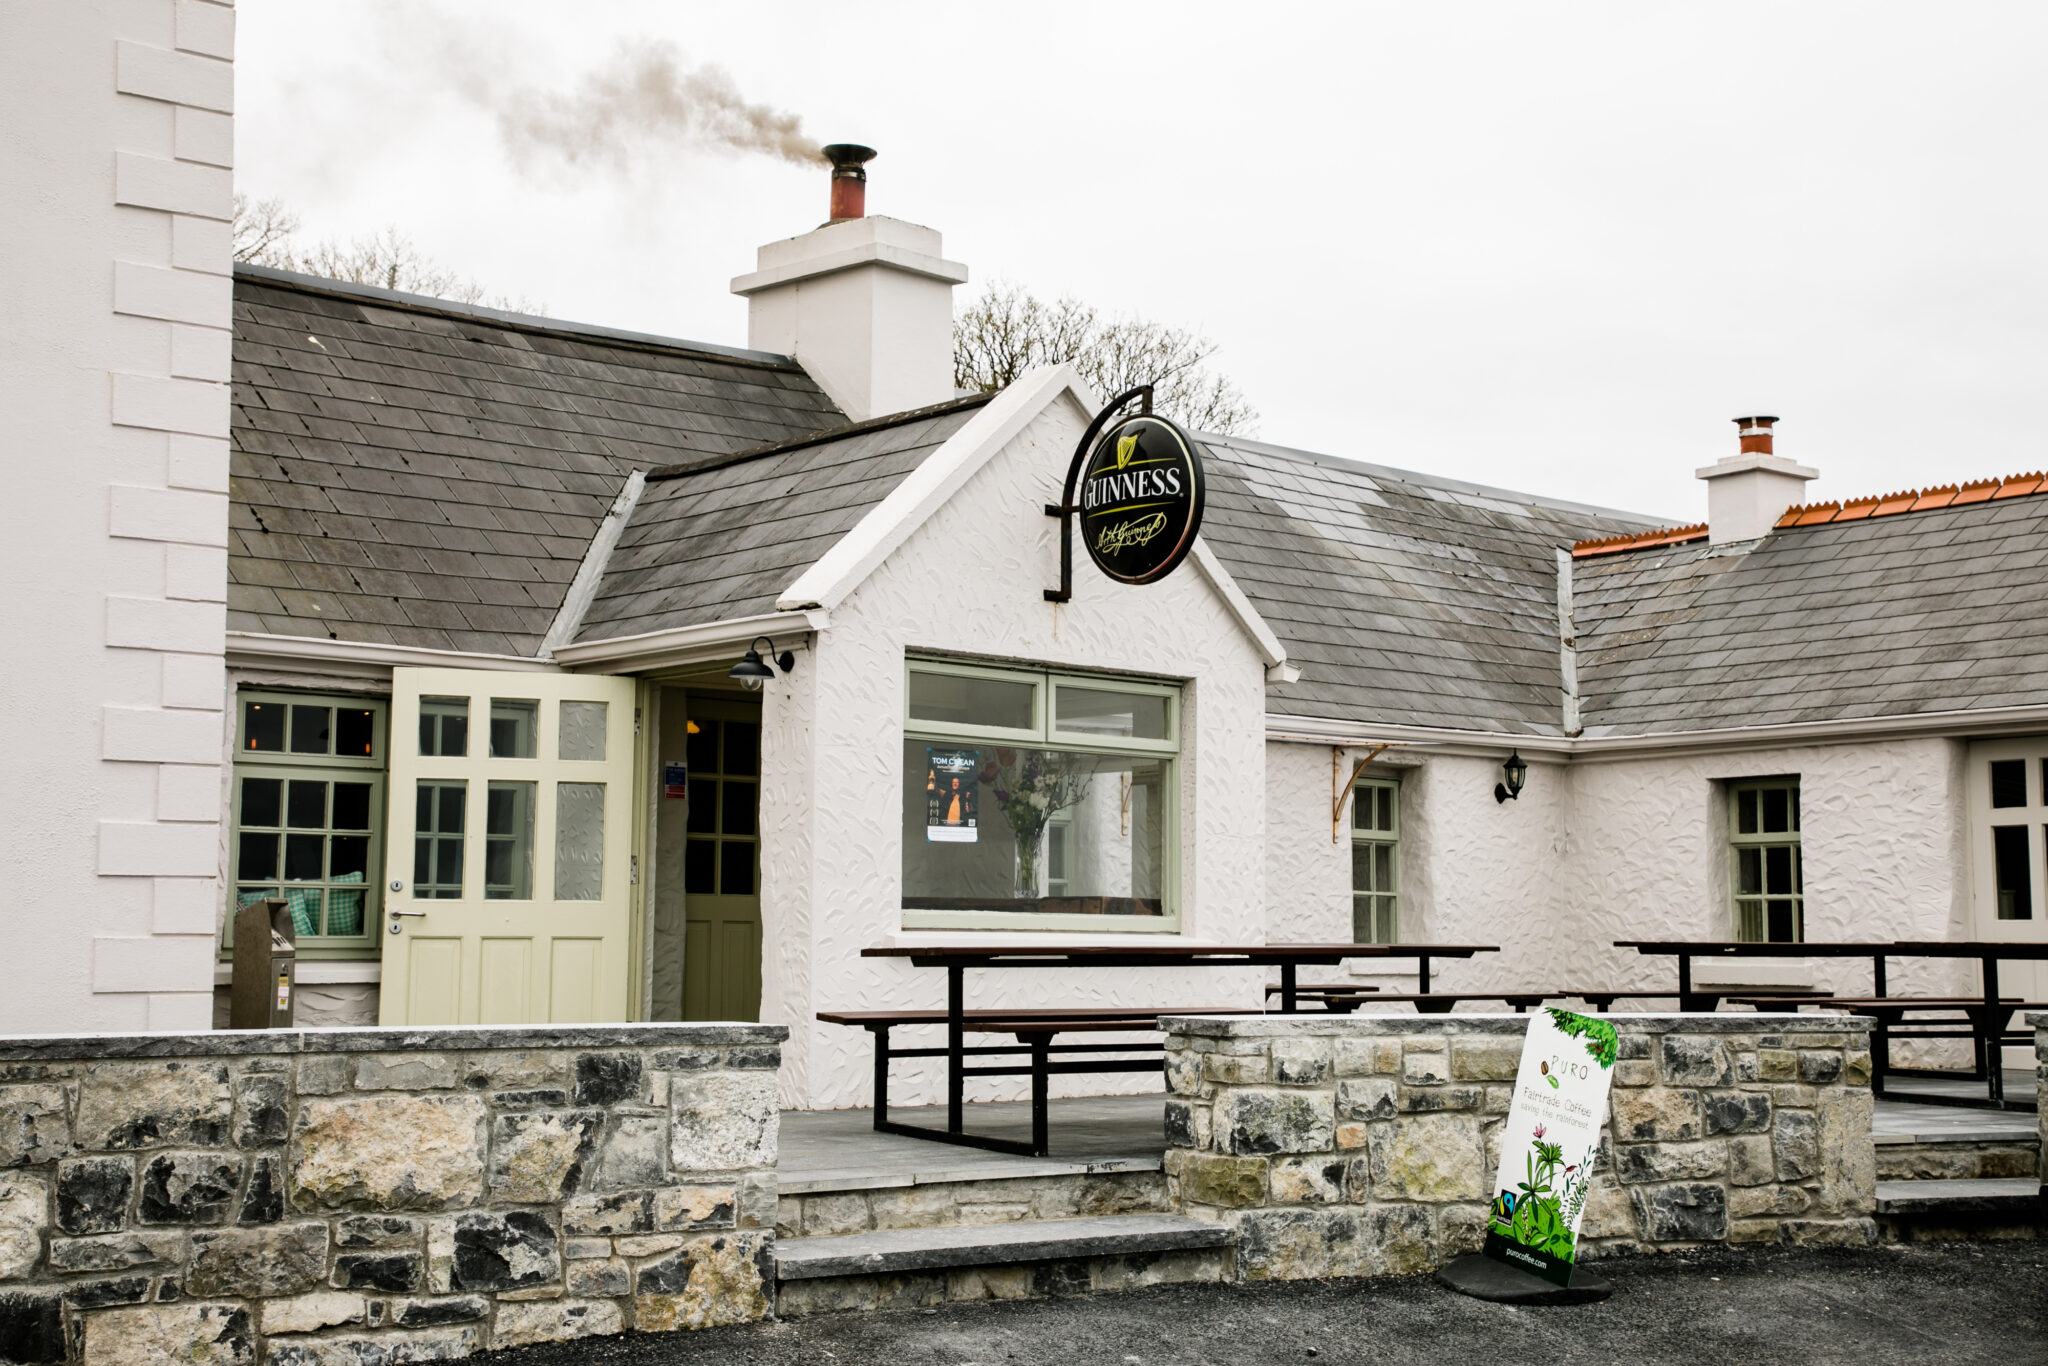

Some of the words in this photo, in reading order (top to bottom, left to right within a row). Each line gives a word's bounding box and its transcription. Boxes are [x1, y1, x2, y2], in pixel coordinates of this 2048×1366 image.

[1084, 467, 1180, 510] GUINNESS
[932, 756, 947, 764] TOM
[1551, 1055, 1588, 1080] PURO
[1523, 1086, 1560, 1107] Fairtrade
[1565, 1098, 1591, 1117] Coffee
[1520, 1103, 1540, 1117] saving
[1543, 1107, 1553, 1118] the
[1556, 1113, 1588, 1129] rainforest
[1506, 1248, 1547, 1269] purocoffee.com
